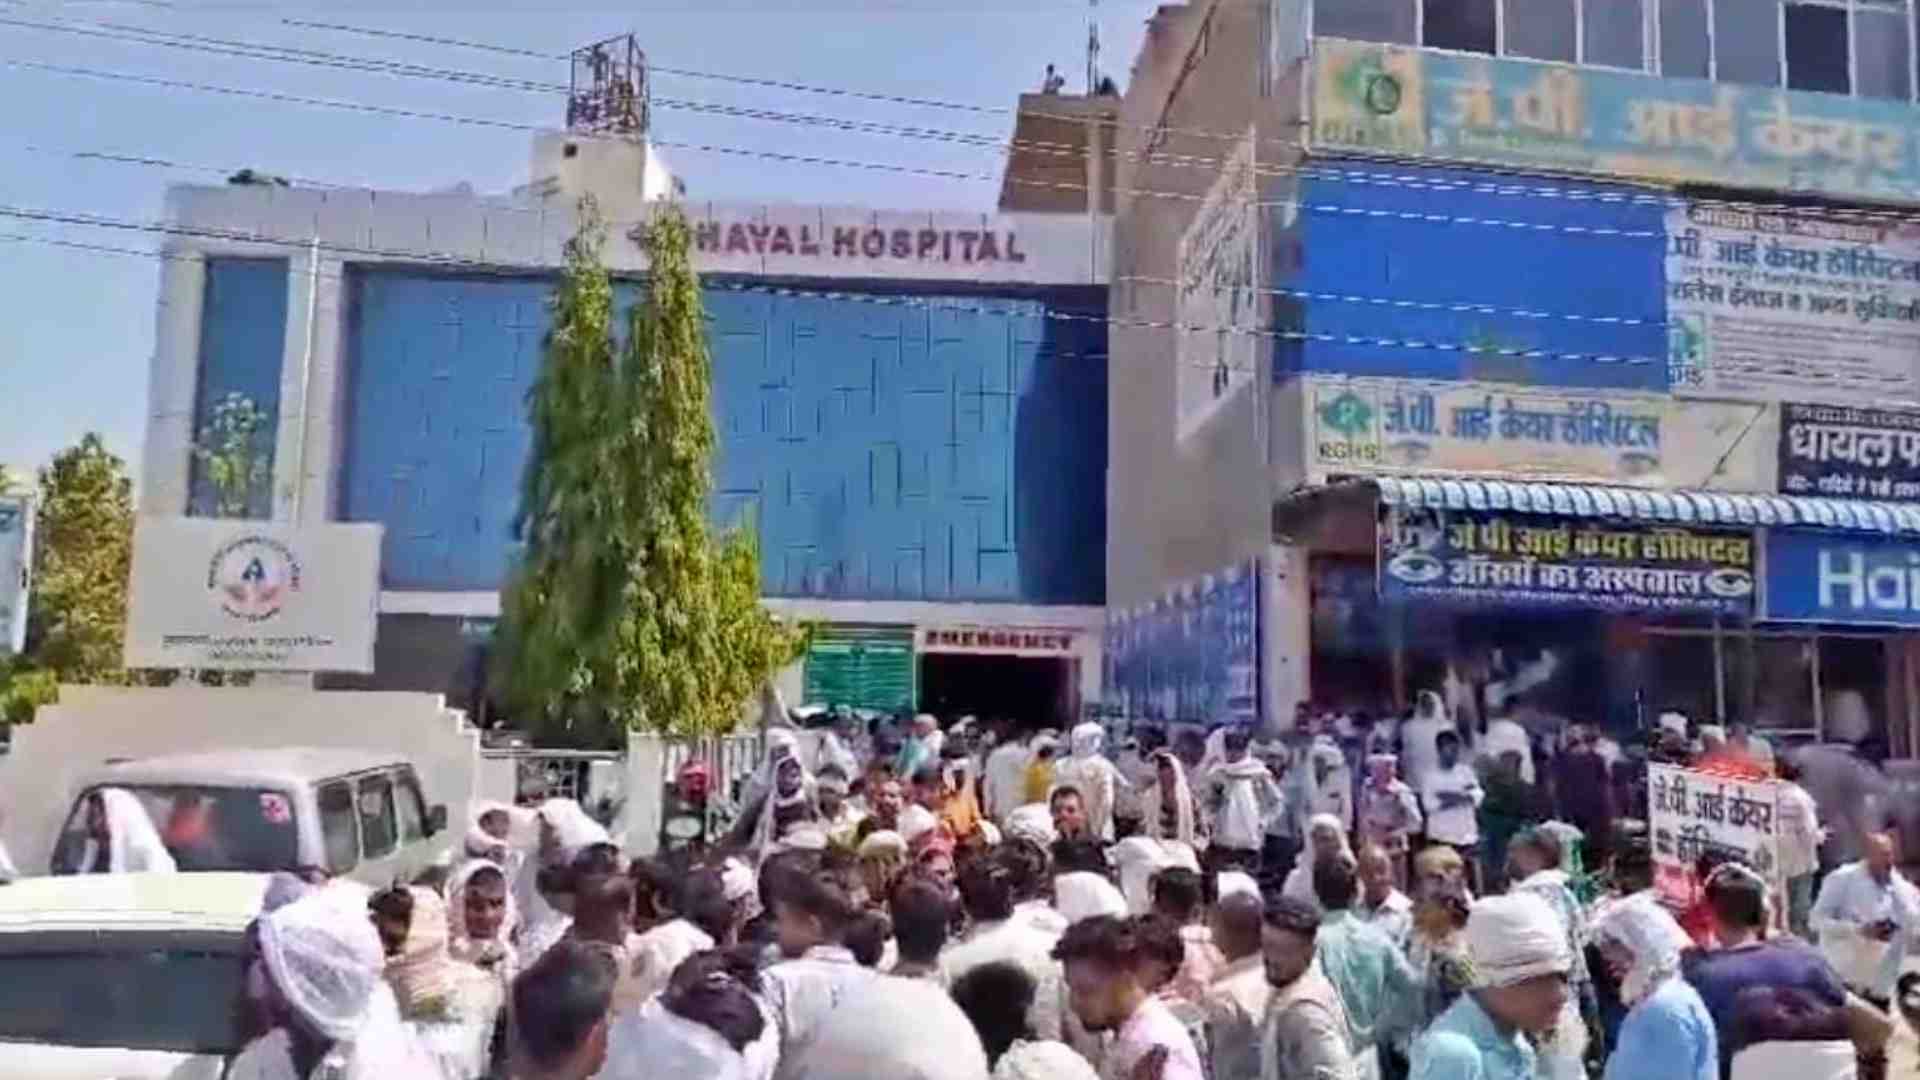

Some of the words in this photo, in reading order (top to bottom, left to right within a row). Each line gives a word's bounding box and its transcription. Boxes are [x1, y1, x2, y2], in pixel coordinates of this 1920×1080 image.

[694, 220, 820, 256] HAYAL
[832, 224, 1026, 264] HOSPITAL
[925, 629, 1071, 650] EMERGENCY
